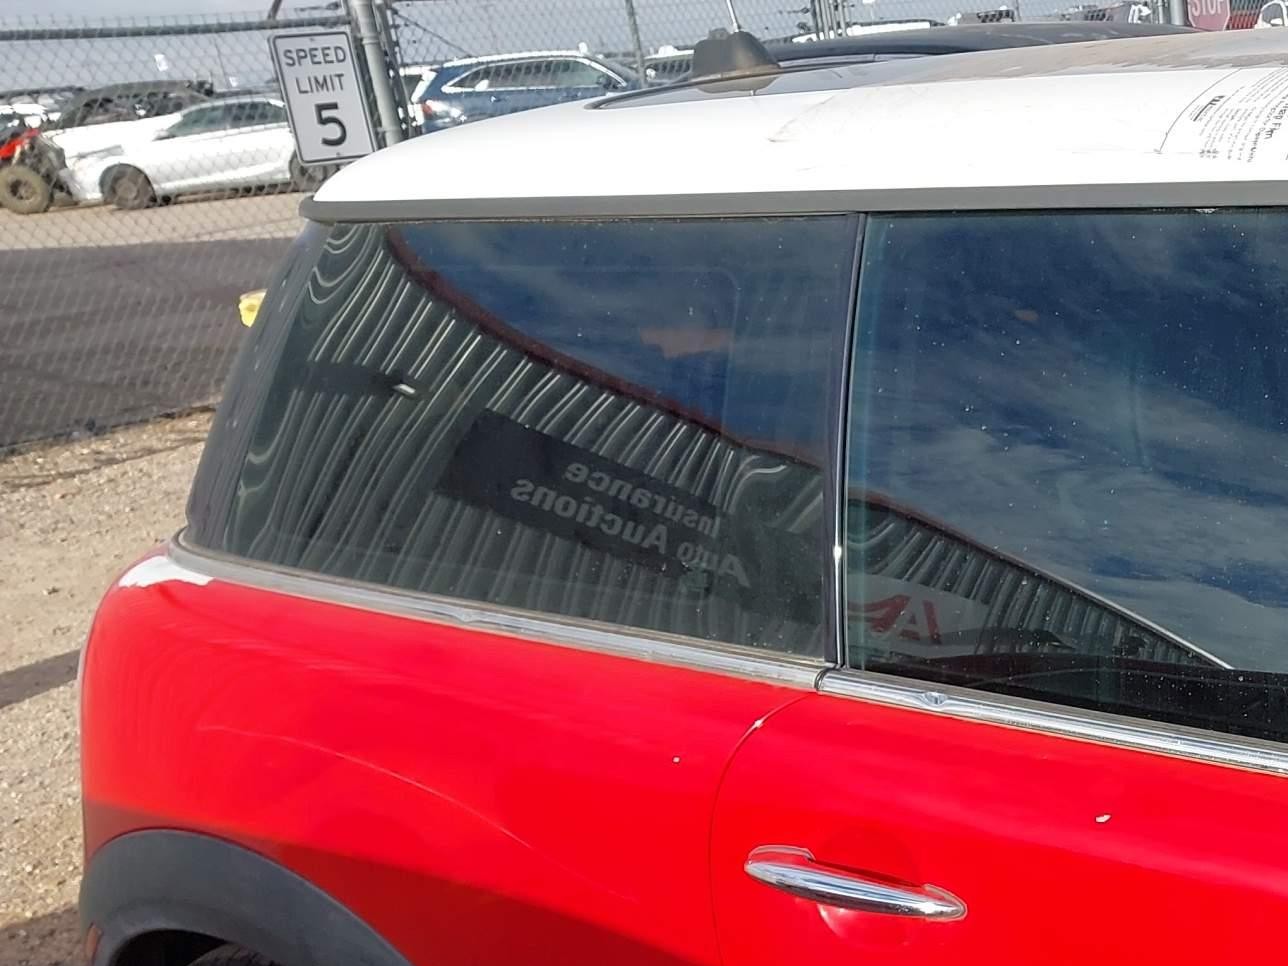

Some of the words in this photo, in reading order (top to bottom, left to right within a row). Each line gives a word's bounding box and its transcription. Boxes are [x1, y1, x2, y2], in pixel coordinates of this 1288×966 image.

[283, 46, 347, 67] SPEED
[295, 73, 345, 94] LIMIT
[315, 101, 347, 147] 5
